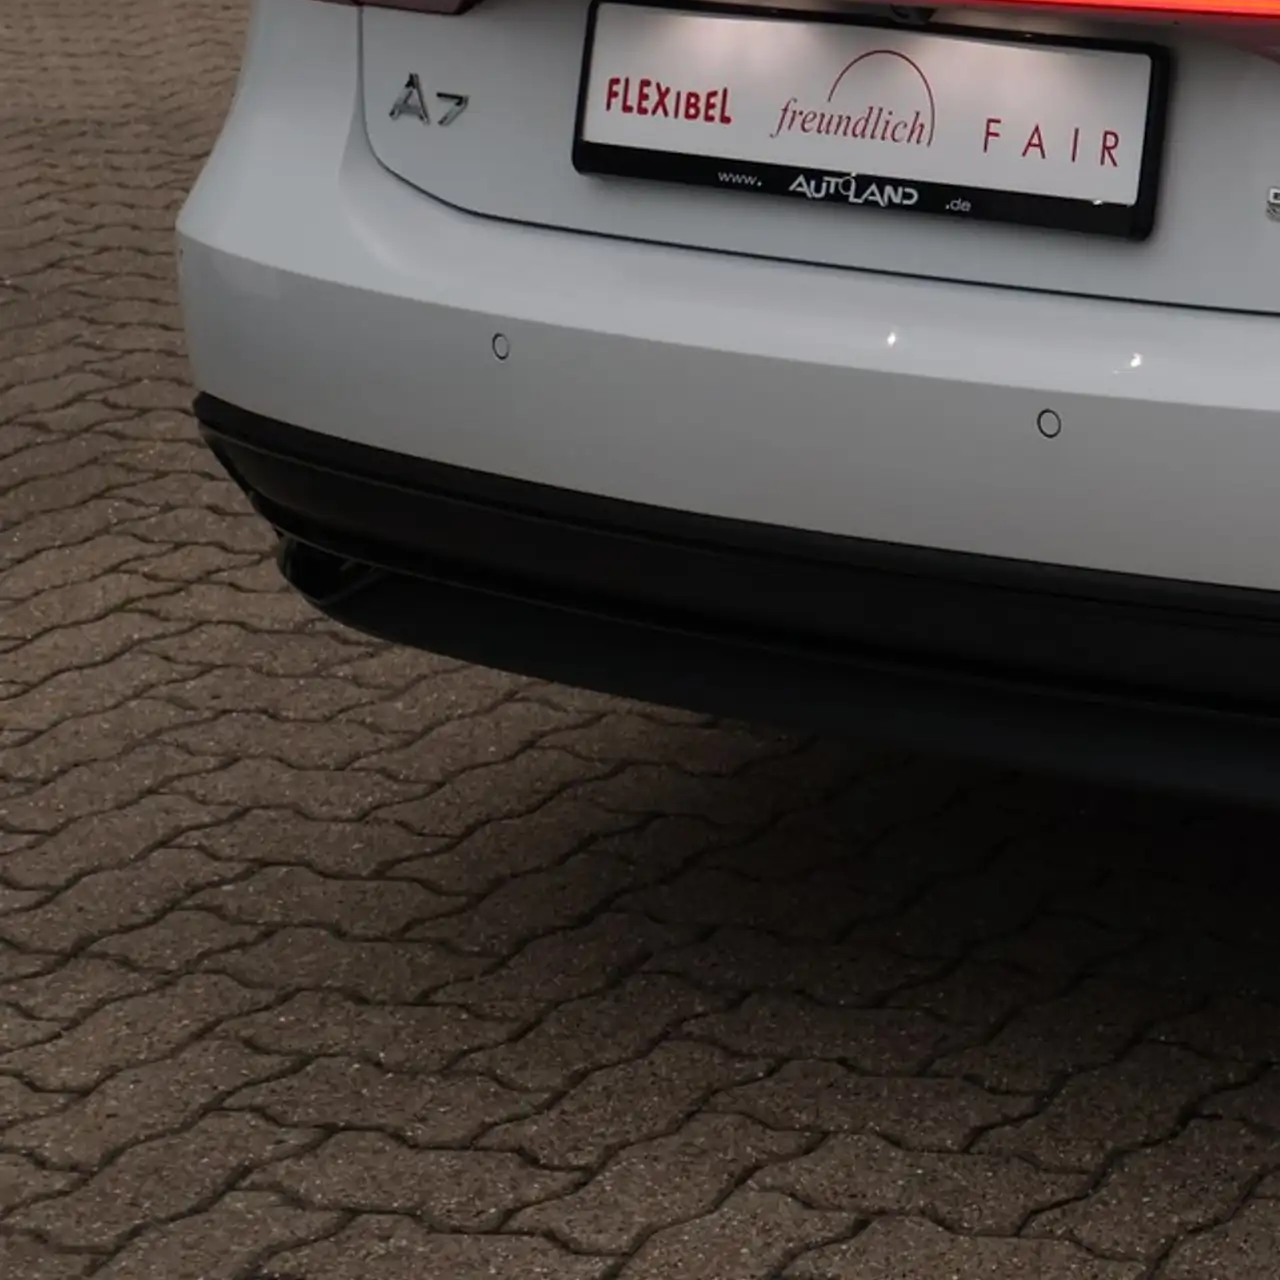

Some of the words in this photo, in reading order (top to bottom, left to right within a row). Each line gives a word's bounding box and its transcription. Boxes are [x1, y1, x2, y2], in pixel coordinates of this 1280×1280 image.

[389, 71, 469, 127] A7
[605, 76, 733, 125] FLEXIBEL
[769, 97, 926, 146] freundlich
[983, 118, 1120, 168] FAIR
[788, 172, 919, 208] AUTOLAND
